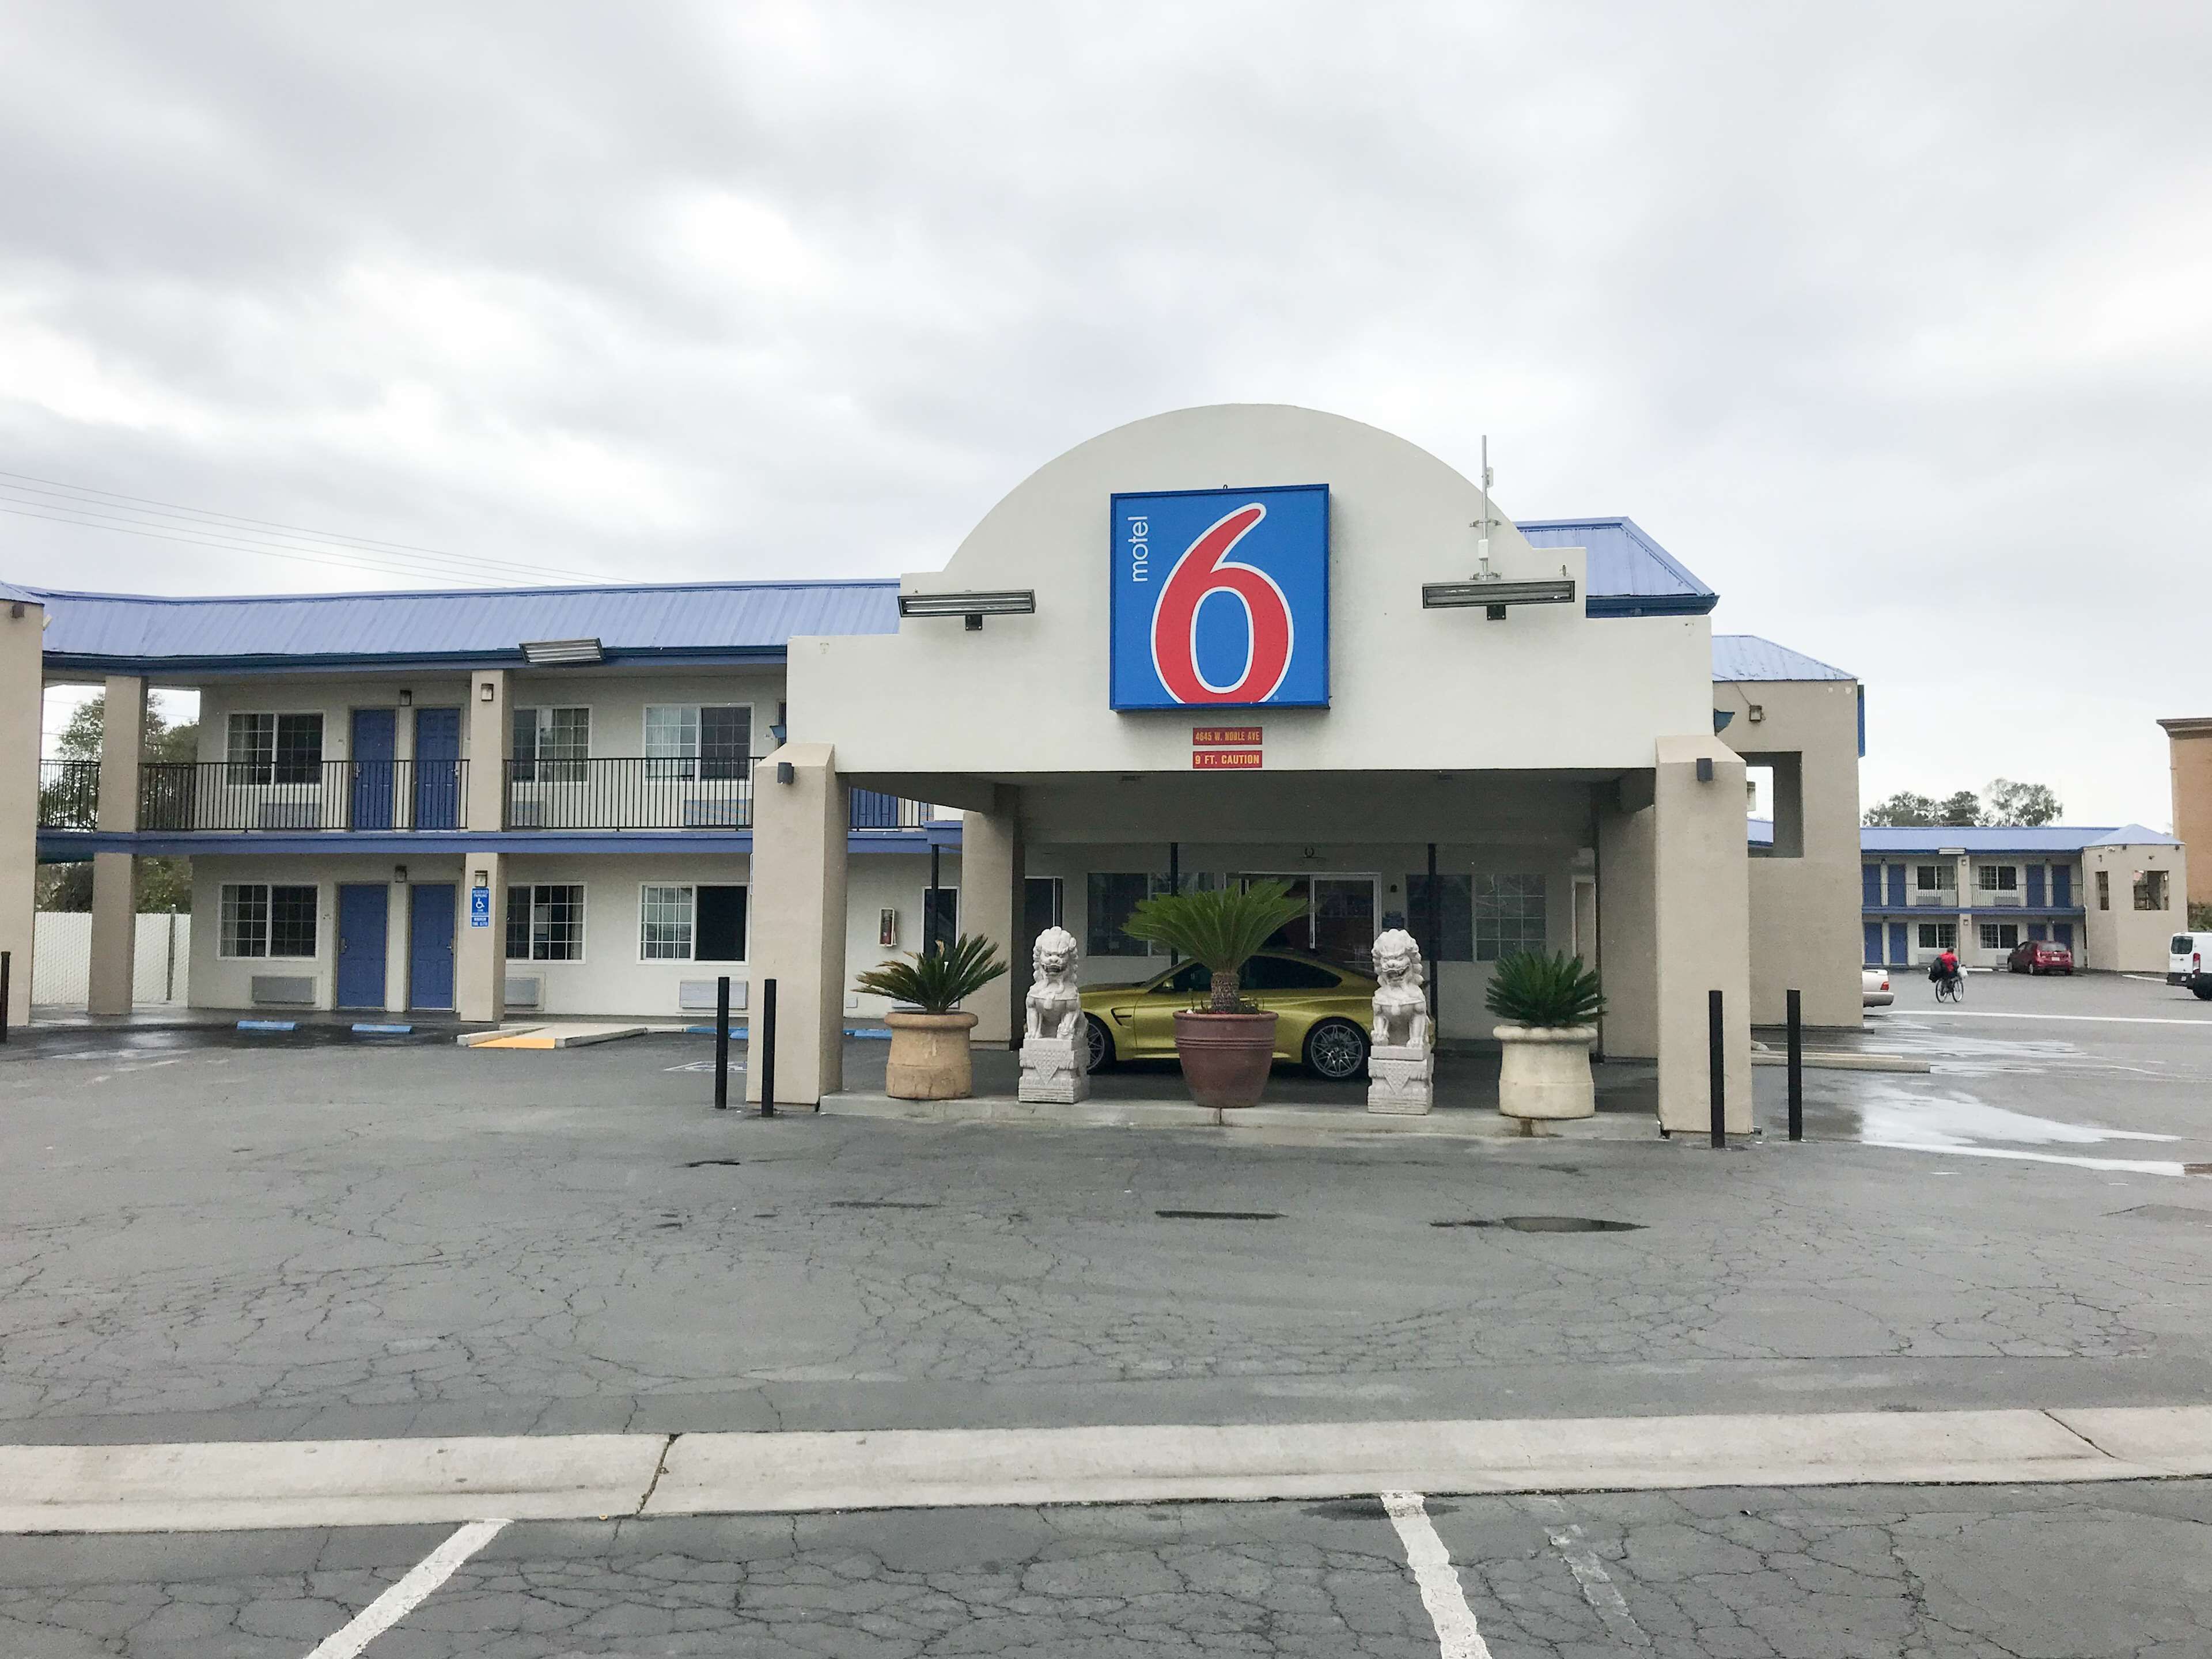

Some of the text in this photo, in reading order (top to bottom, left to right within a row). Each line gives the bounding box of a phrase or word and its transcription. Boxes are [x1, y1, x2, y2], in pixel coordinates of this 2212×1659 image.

[1127, 516, 1149, 582] motel
[1150, 502, 1294, 703] 6
[1195, 732, 1260, 741] 4645 W. NOBLE AVE
[1195, 755, 1259, 764] 9 FT. CAUTION
